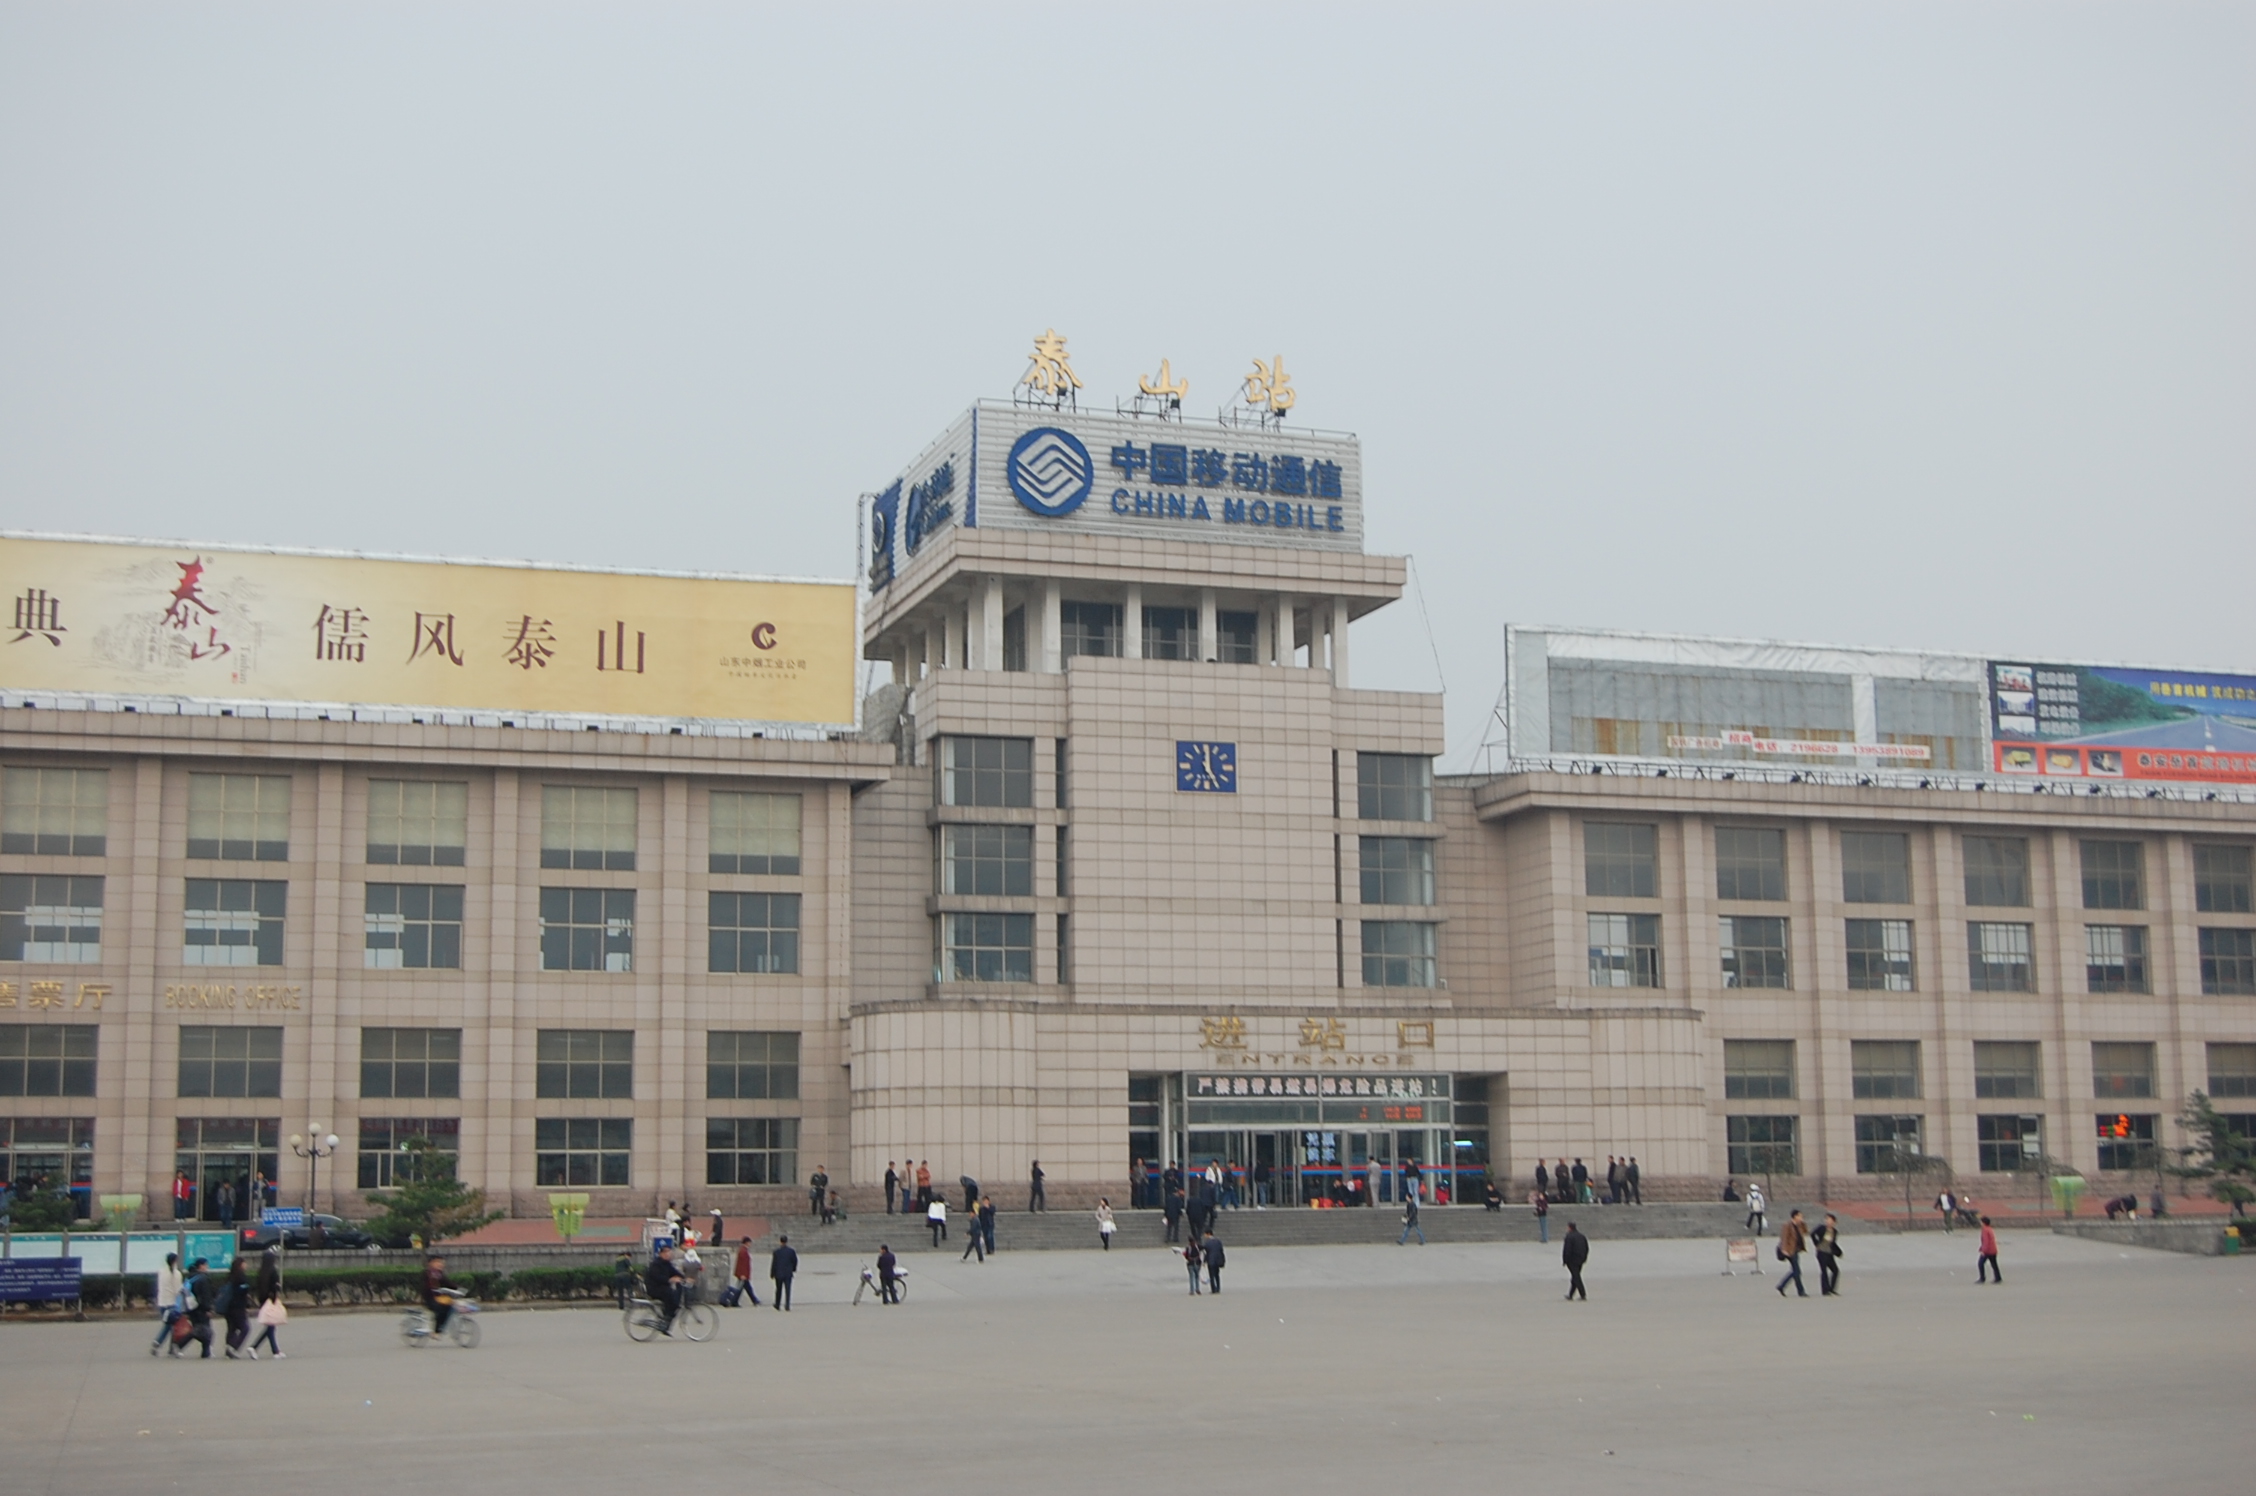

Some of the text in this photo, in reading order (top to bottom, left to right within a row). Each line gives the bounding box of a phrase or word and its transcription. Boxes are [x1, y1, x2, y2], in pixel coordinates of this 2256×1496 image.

[1024, 328, 1296, 411] 泰山站
[1111, 440, 1343, 500] 中国移动通信
[1111, 488, 1345, 532] CHINA MOBILE
[7, 587, 69, 647] 典
[312, 603, 646, 675] 儒风泰山
[719, 656, 807, 671] 山东中烟工业公司
[1728, 732, 1753, 746] 招商
[165, 983, 302, 1011] BOOKING OFFICE
[1199, 1015, 1436, 1051] 进站口
[1216, 1053, 1416, 1067] ENTRANCE
